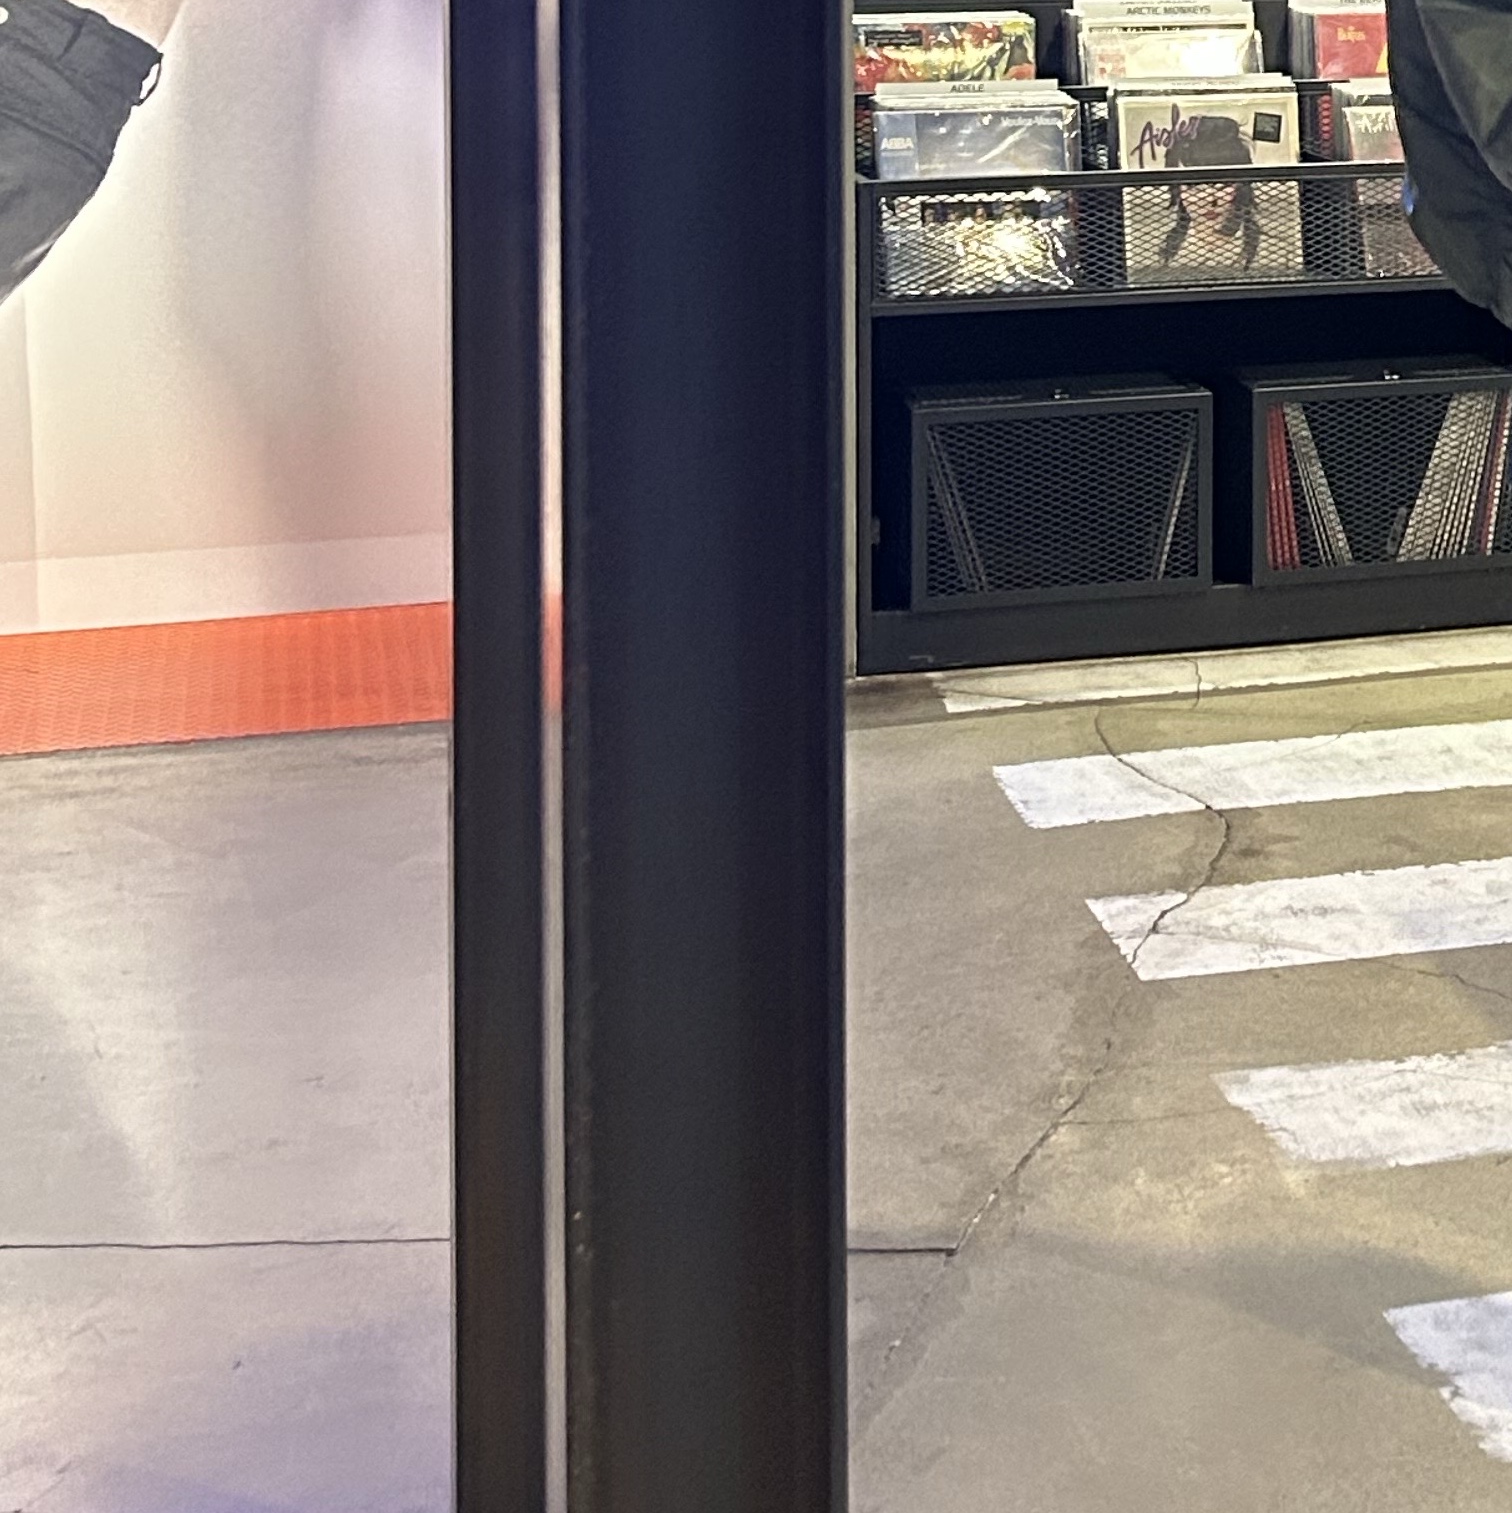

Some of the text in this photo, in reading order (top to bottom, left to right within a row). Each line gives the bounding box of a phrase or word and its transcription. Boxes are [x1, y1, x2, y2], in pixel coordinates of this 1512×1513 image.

[1126, 6, 1158, 15] ARCTIC
[950, 84, 985, 93] ADELE
[1130, 102, 1202, 169] Aisles
